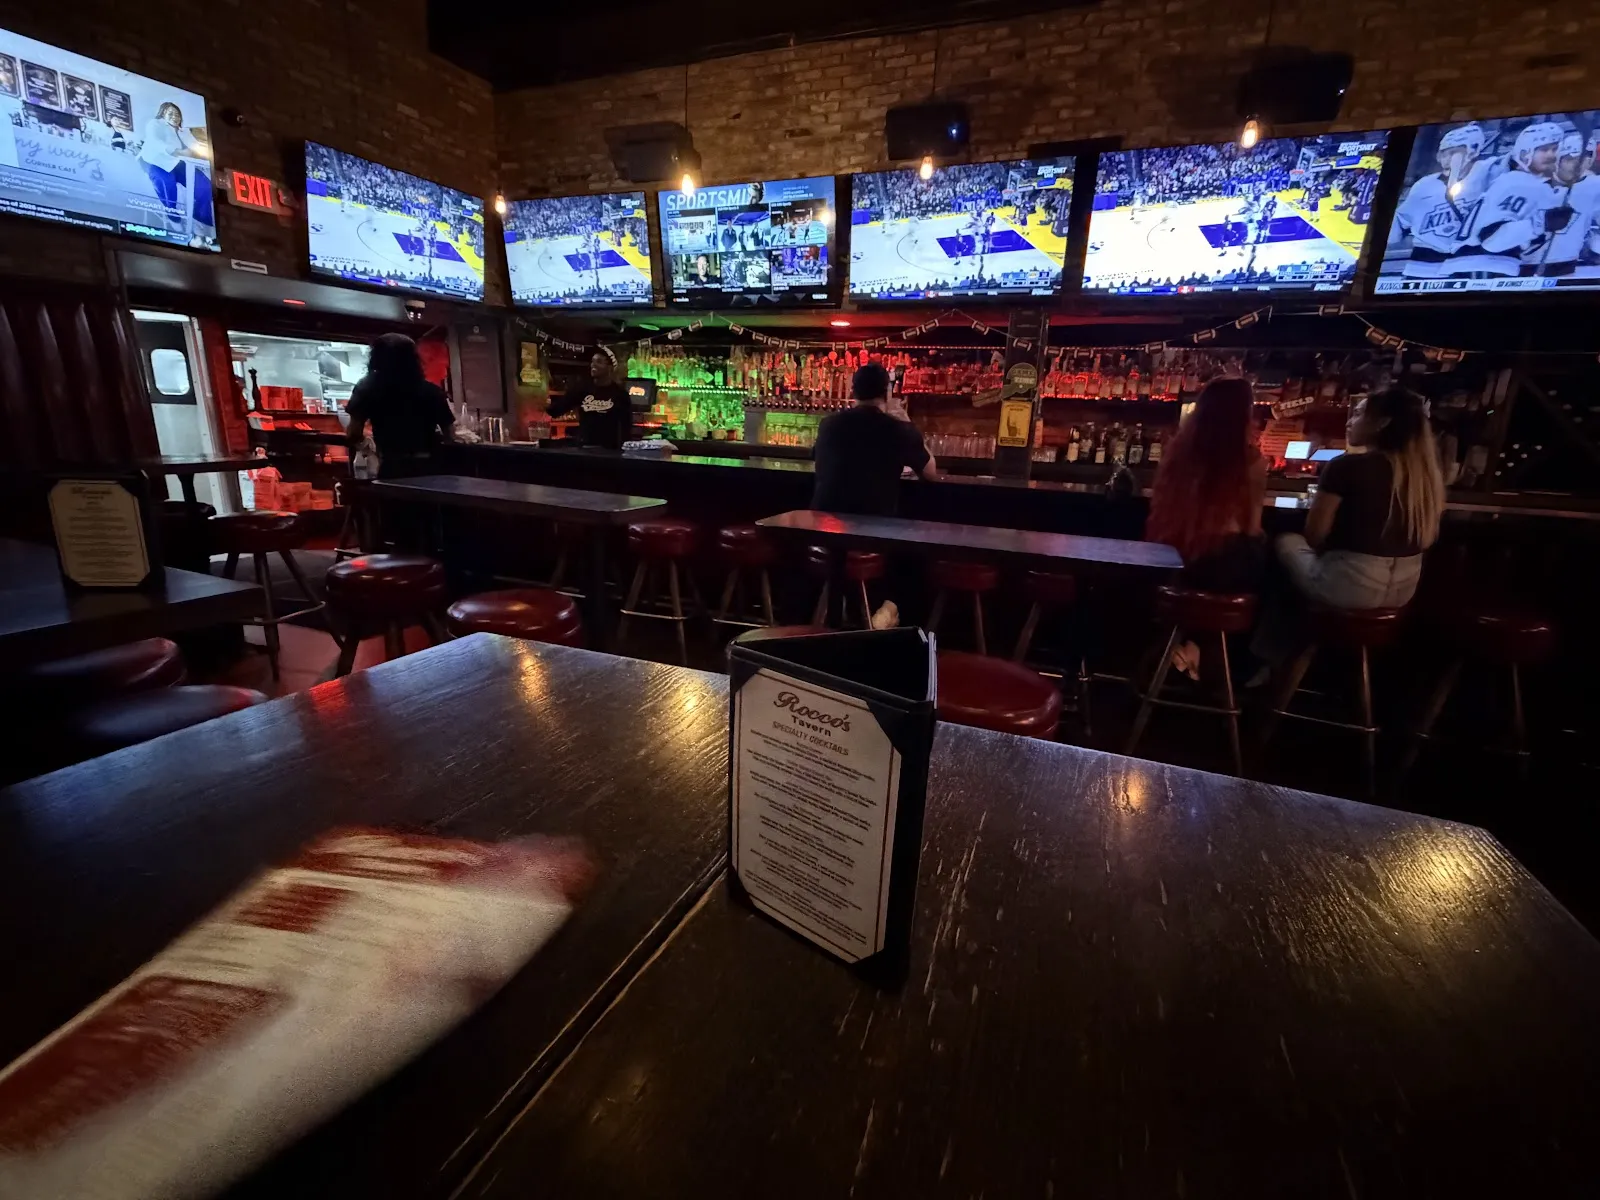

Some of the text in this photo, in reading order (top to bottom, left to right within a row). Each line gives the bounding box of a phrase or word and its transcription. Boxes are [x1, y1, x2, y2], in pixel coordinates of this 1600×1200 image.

[233, 171, 273, 209] EXIT
[1498, 194, 1526, 213] 40
[773, 691, 851, 732] Rocco's
[791, 715, 831, 737] Tavern
[772, 721, 849, 756] SPECIALTY COCKTAILS
